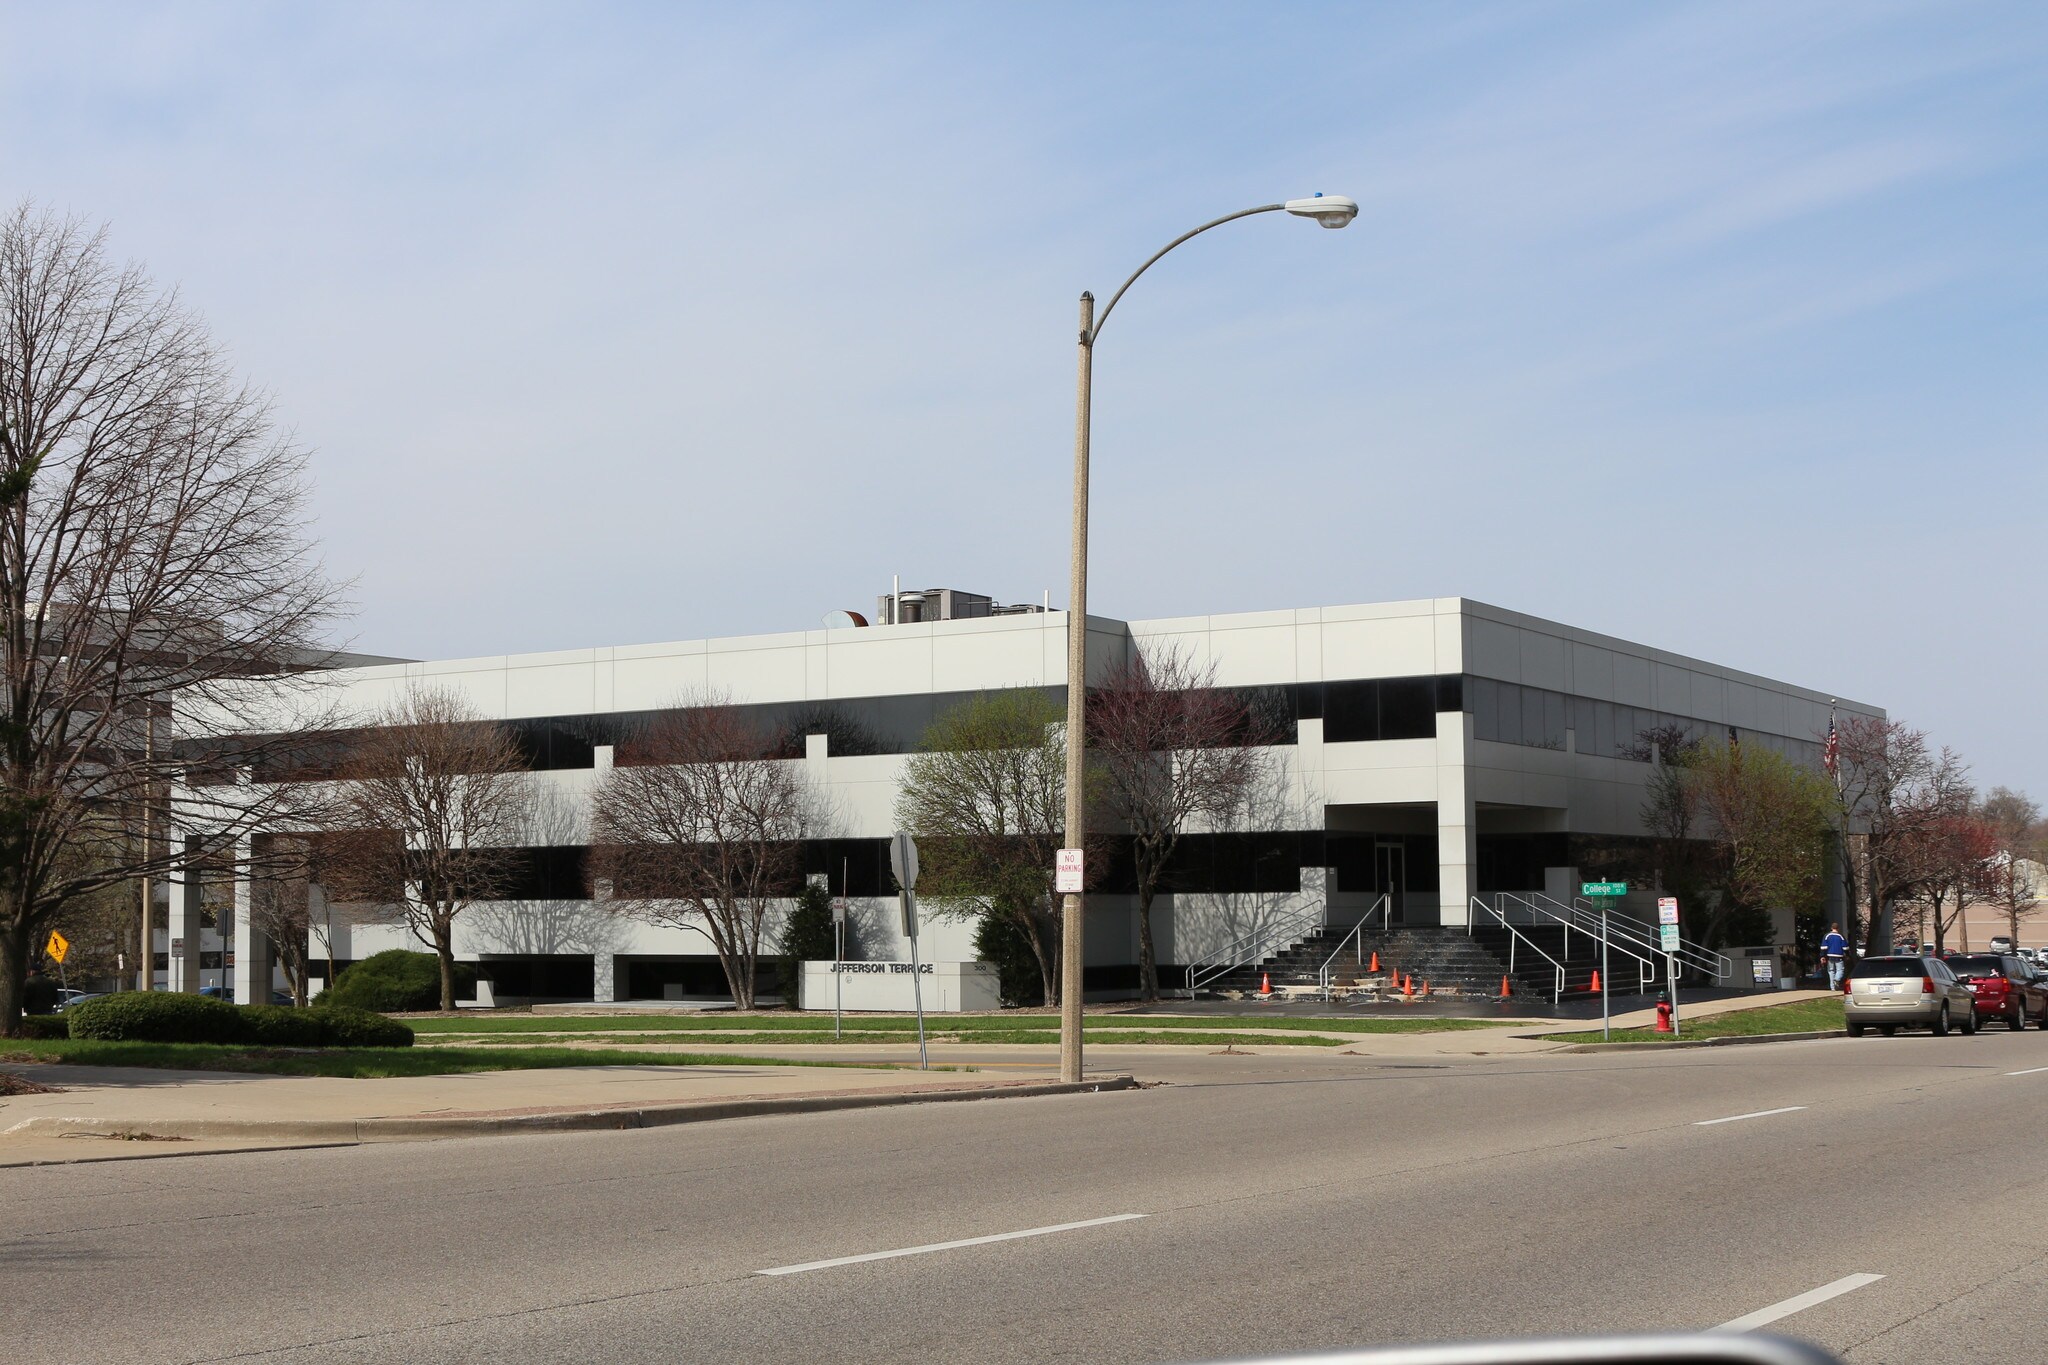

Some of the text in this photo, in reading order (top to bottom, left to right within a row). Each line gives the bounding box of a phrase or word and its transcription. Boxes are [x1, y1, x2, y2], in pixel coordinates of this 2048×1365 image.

[1065, 855, 1075, 863] NO
[1583, 884, 1611, 895] College
[830, 963, 934, 974] JEFFERSON TERRCE
